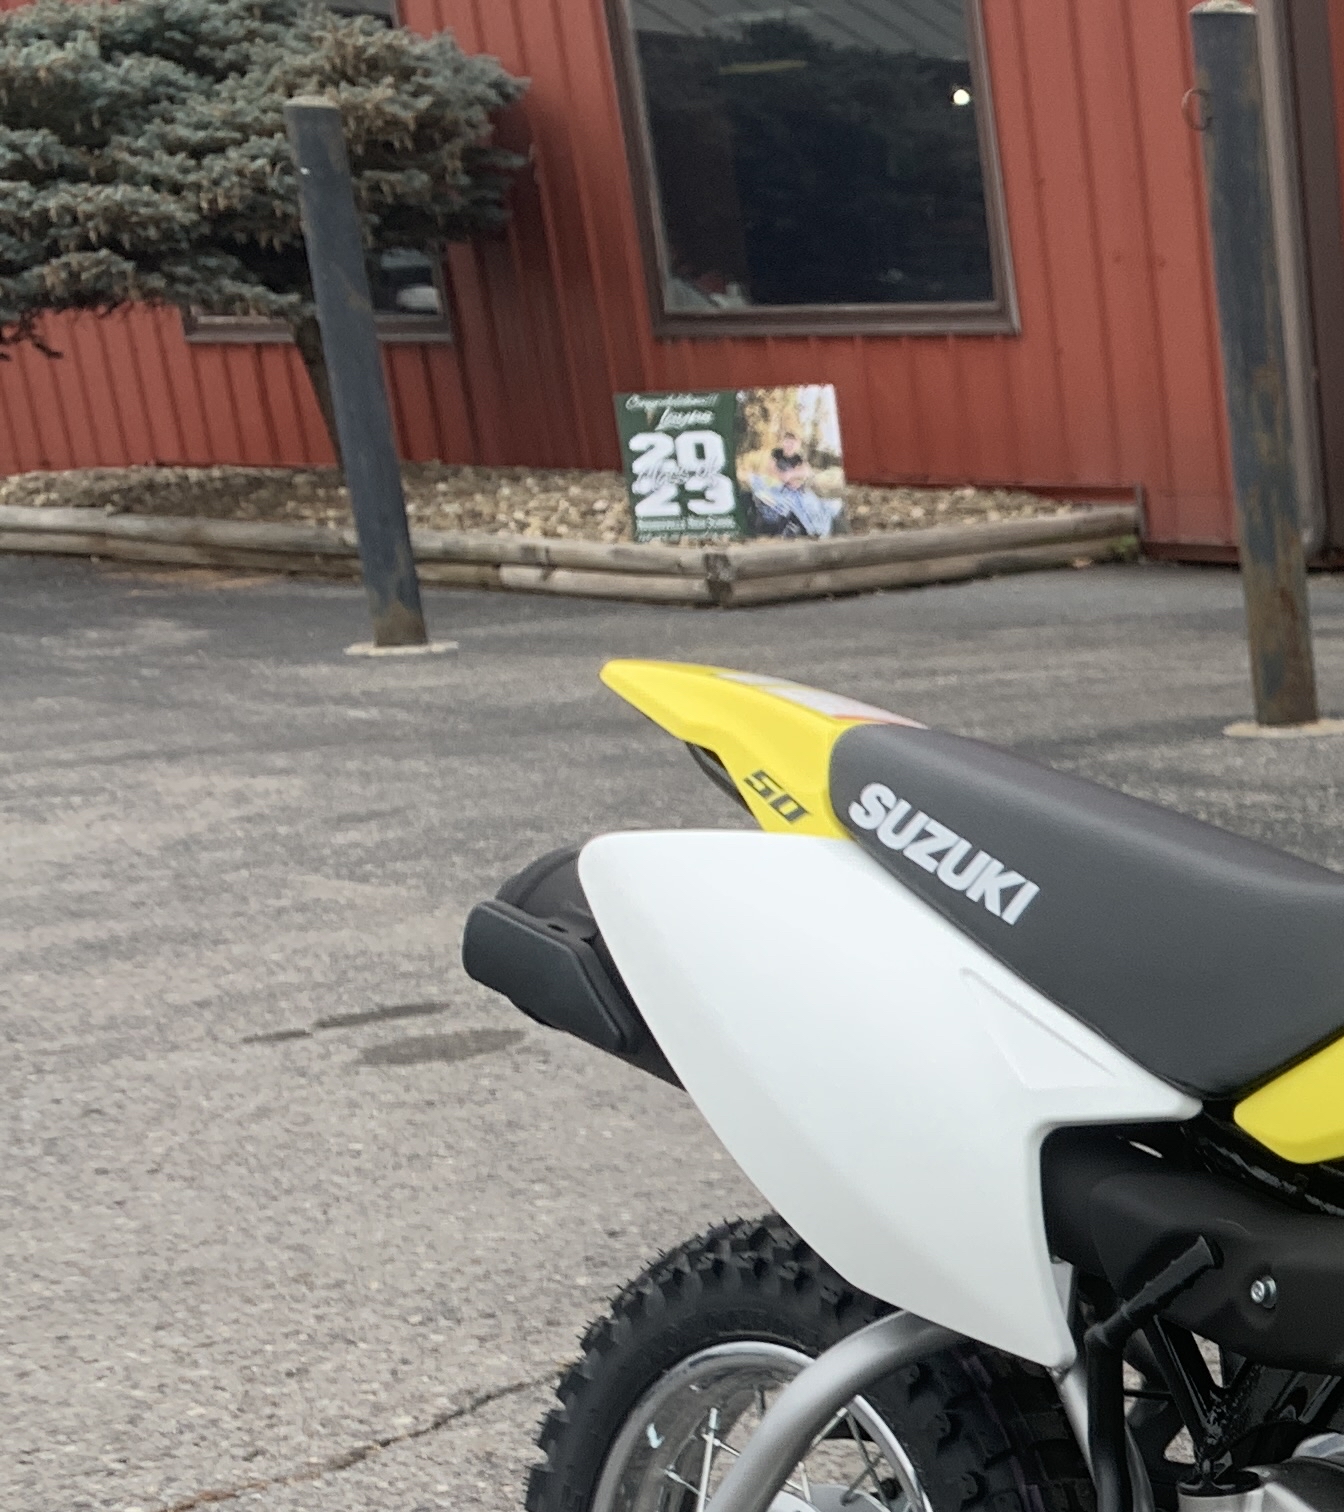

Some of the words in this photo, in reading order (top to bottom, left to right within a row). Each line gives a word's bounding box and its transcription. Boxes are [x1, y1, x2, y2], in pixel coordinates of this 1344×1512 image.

[628, 429, 726, 476] 20
[631, 460, 736, 517] 23
[742, 769, 811, 824] 50
[848, 782, 1041, 927] SUZUKI
